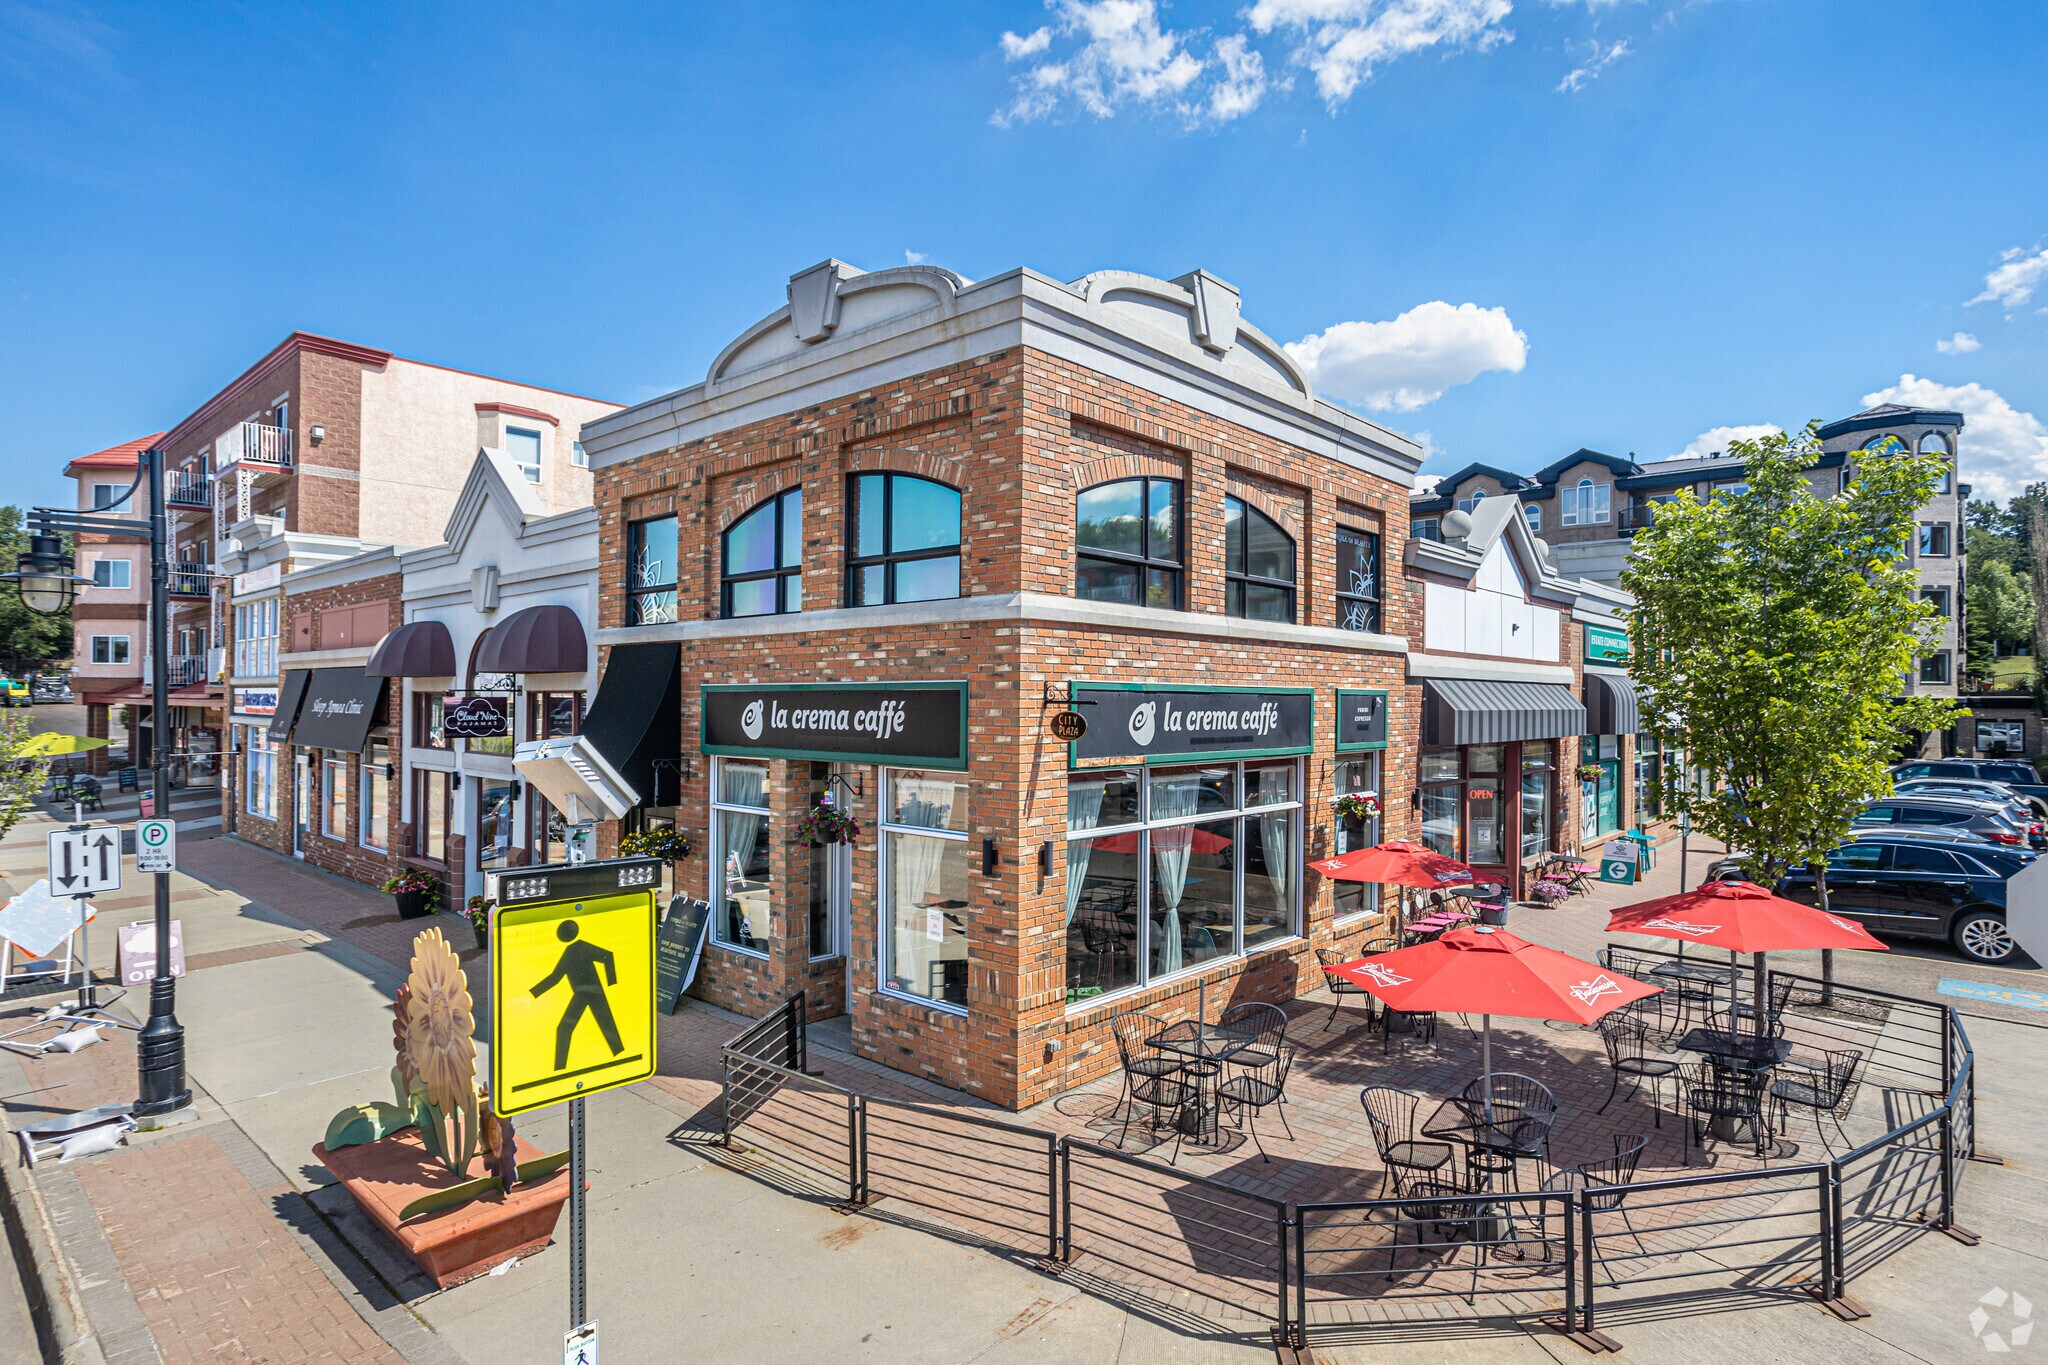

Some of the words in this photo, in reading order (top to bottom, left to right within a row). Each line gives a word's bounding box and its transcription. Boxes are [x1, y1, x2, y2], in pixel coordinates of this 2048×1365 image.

[1604, 637, 1628, 649] CONNECTION
[311, 697, 327, 717] Sleep
[325, 699, 345, 717] Apnea
[344, 698, 364, 714] Clinic
[456, 710, 480, 721] Cloud
[480, 710, 498, 721] Nine
[770, 699, 788, 729] la
[791, 708, 850, 731] crema
[853, 700, 906, 739] caffé
[1058, 714, 1078, 725] CITY
[1163, 701, 1182, 732] la
[1185, 709, 1238, 732] crema
[1241, 702, 1279, 735] caffé
[1058, 725, 1079, 736] PLAZA
[1469, 789, 1494, 800] OPEN
[150, 828, 161, 841] P
[128, 965, 180, 982] OPN
[1570, 980, 1616, 1001] Budweiser
